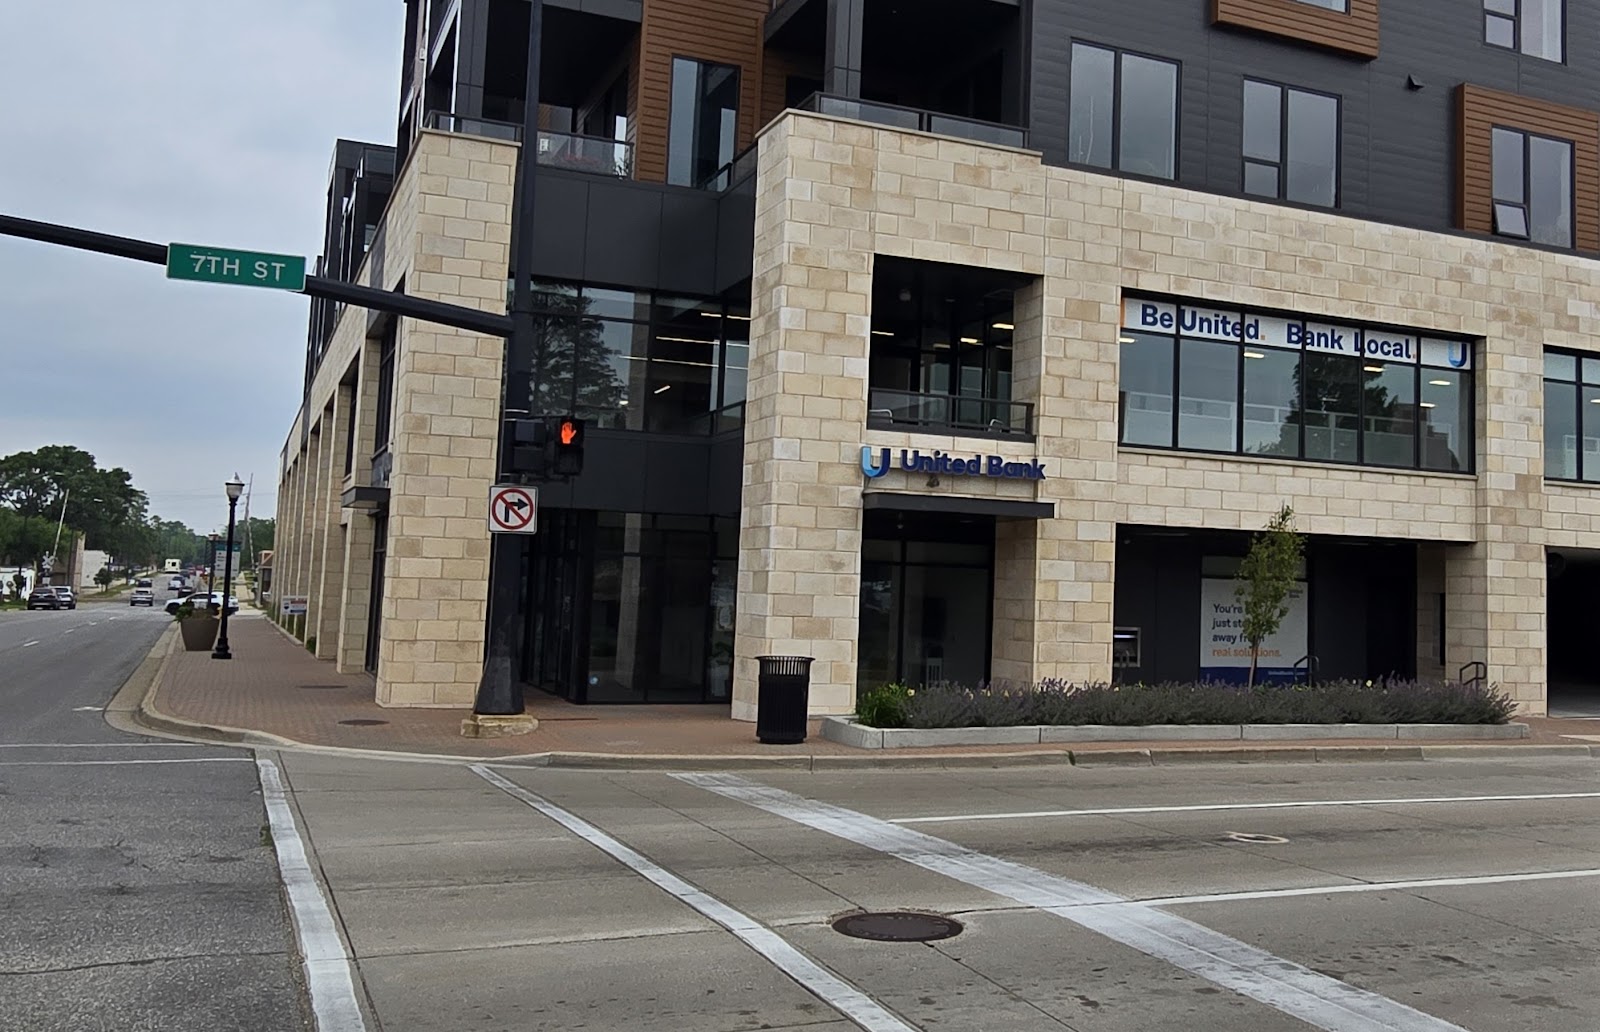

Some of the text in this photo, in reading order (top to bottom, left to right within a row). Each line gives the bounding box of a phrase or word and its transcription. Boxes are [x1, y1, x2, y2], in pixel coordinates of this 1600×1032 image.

[190, 254, 286, 282] 7TH ST
[1141, 303, 1174, 329] Be
[1286, 322, 1344, 351] Bank
[901, 449, 982, 477] United
[985, 455, 1047, 480] Bank
[1213, 603, 1244, 614] You're
[1211, 618, 1231, 630] just
[1212, 634, 1237, 645] away
[1212, 647, 1231, 657] real
